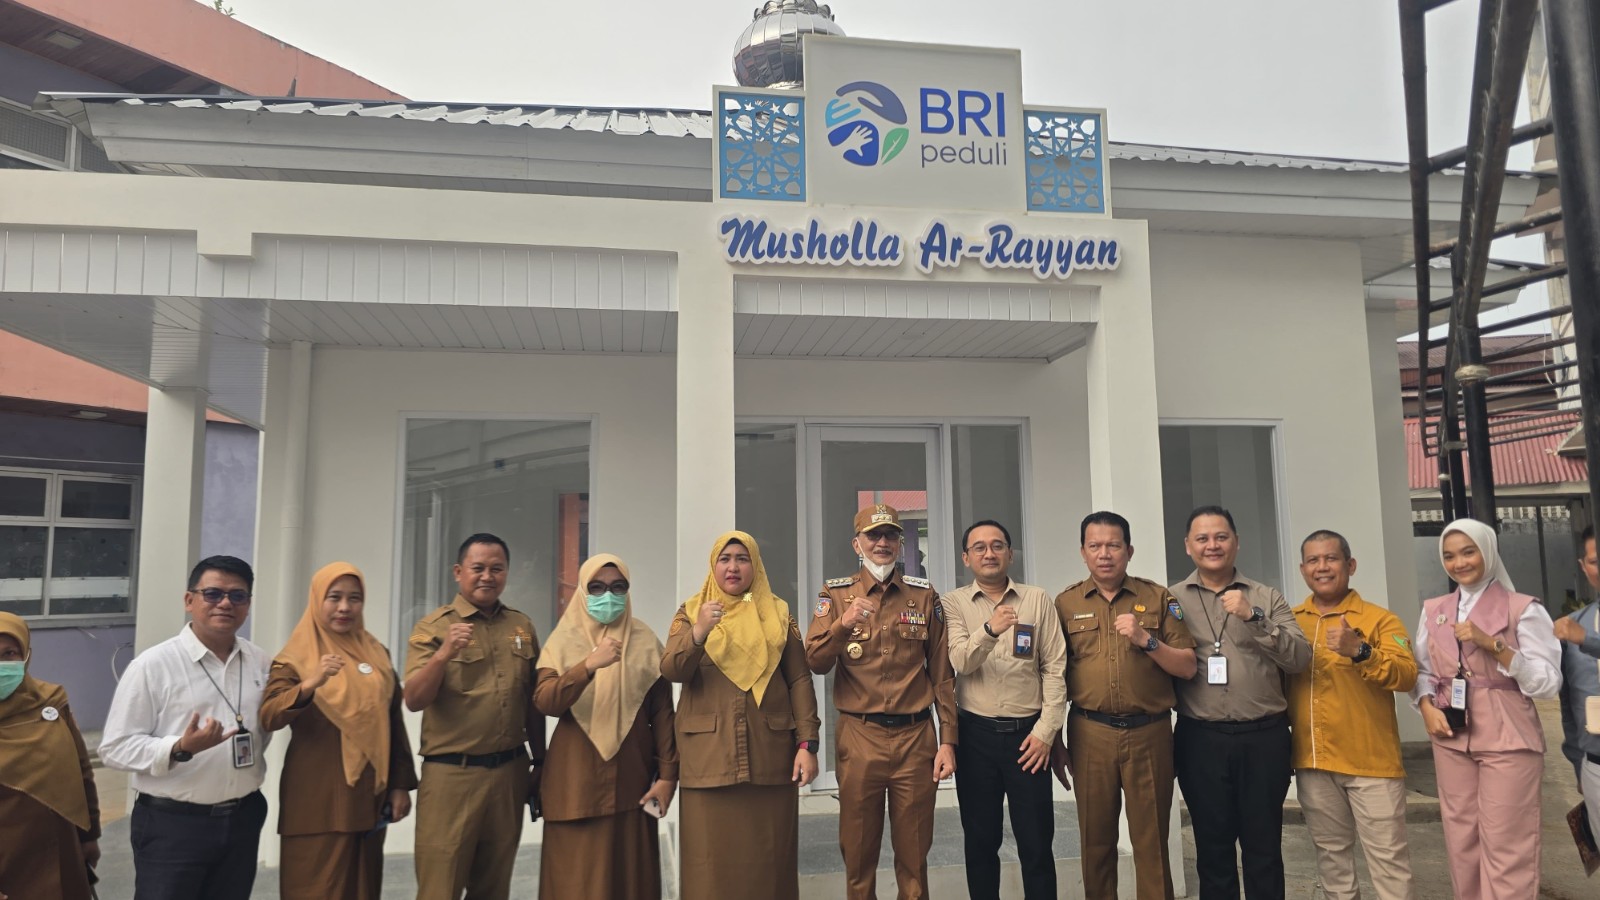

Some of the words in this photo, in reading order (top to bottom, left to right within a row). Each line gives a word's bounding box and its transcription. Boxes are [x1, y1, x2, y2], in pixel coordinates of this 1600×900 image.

[919, 87, 1006, 138] BRI
[920, 140, 1008, 168] peduli
[720, 216, 901, 262] Musholla
[918, 221, 1119, 275] Ar-Rayyan
